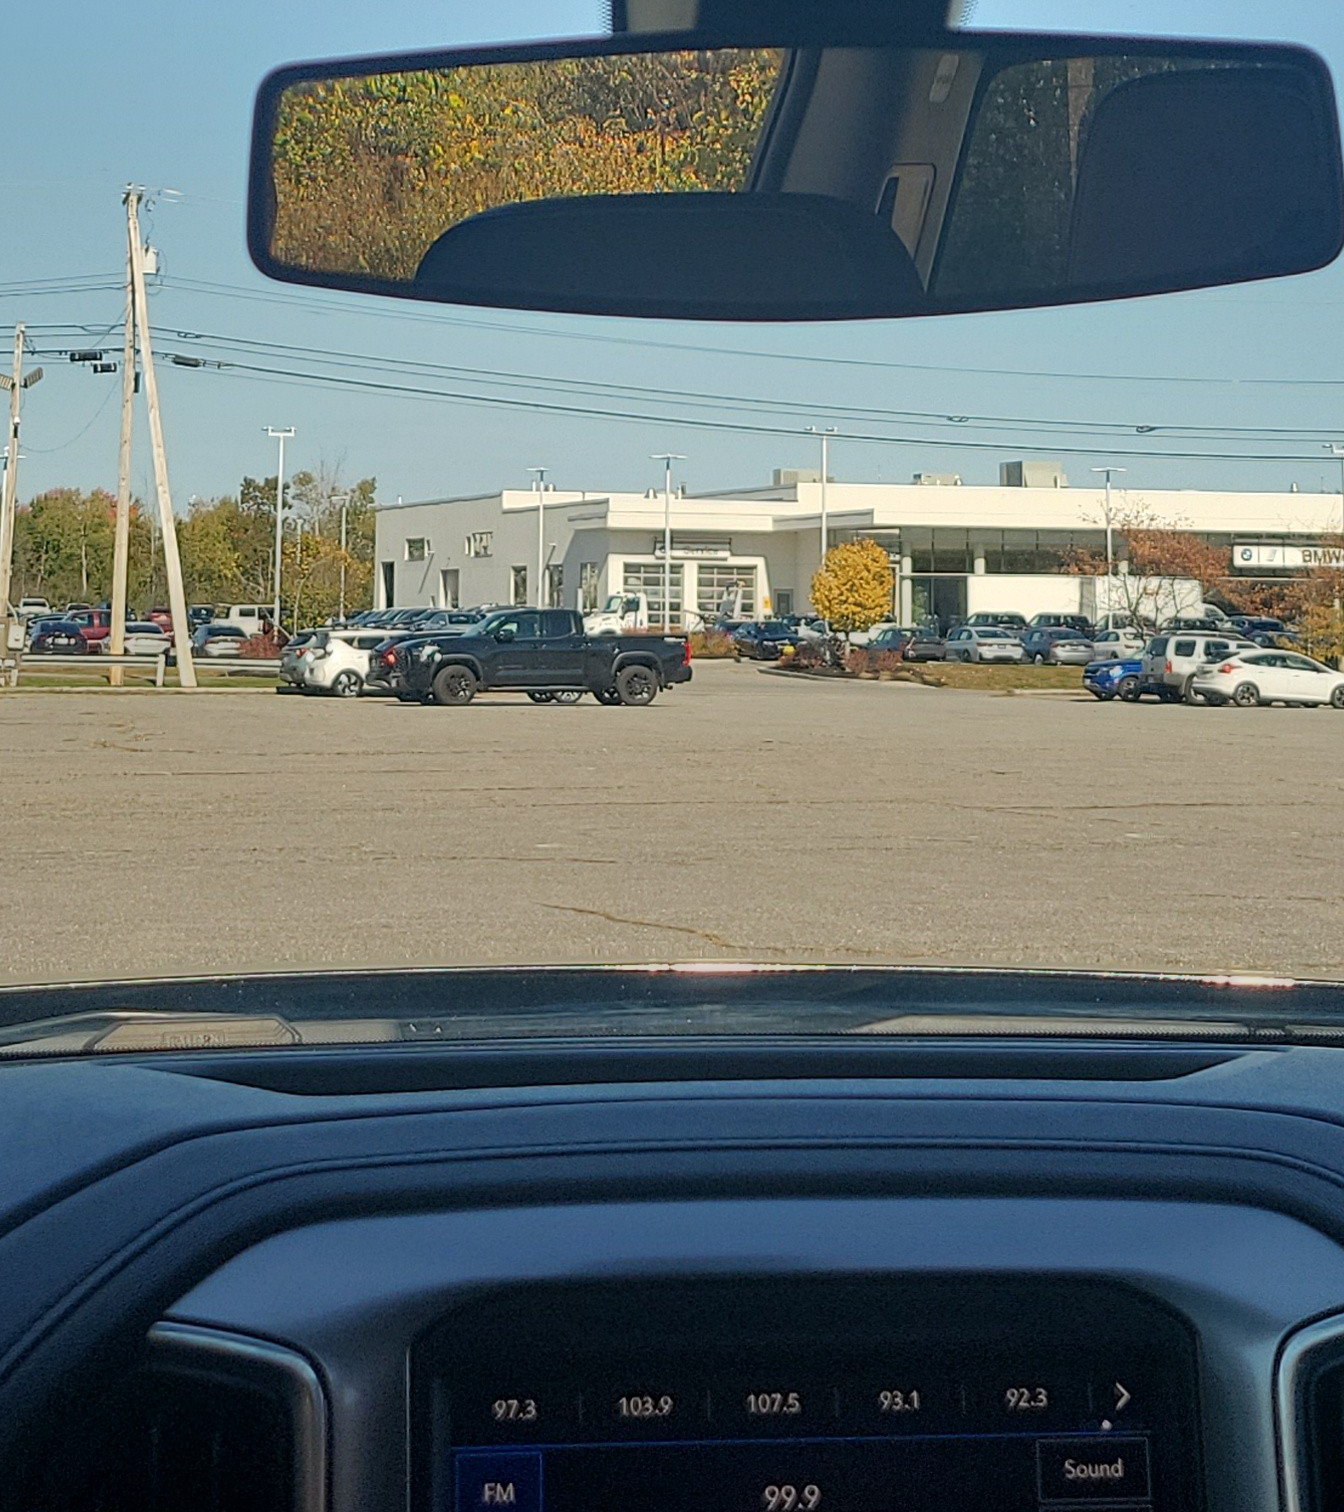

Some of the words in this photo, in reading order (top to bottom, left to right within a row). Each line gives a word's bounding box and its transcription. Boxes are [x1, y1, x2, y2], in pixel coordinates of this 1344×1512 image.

[1301, 549, 1342, 564] BMW
[618, 1396, 673, 1416] 103.9
[747, 1392, 800, 1413] 107.5
[878, 1390, 919, 1410] 93.1
[1005, 1387, 1047, 1408] 92.3
[493, 1399, 536, 1419] 97.3
[1063, 1457, 1124, 1479] Sound
[483, 1482, 515, 1503] FM
[764, 1483, 820, 1510] 99.9
